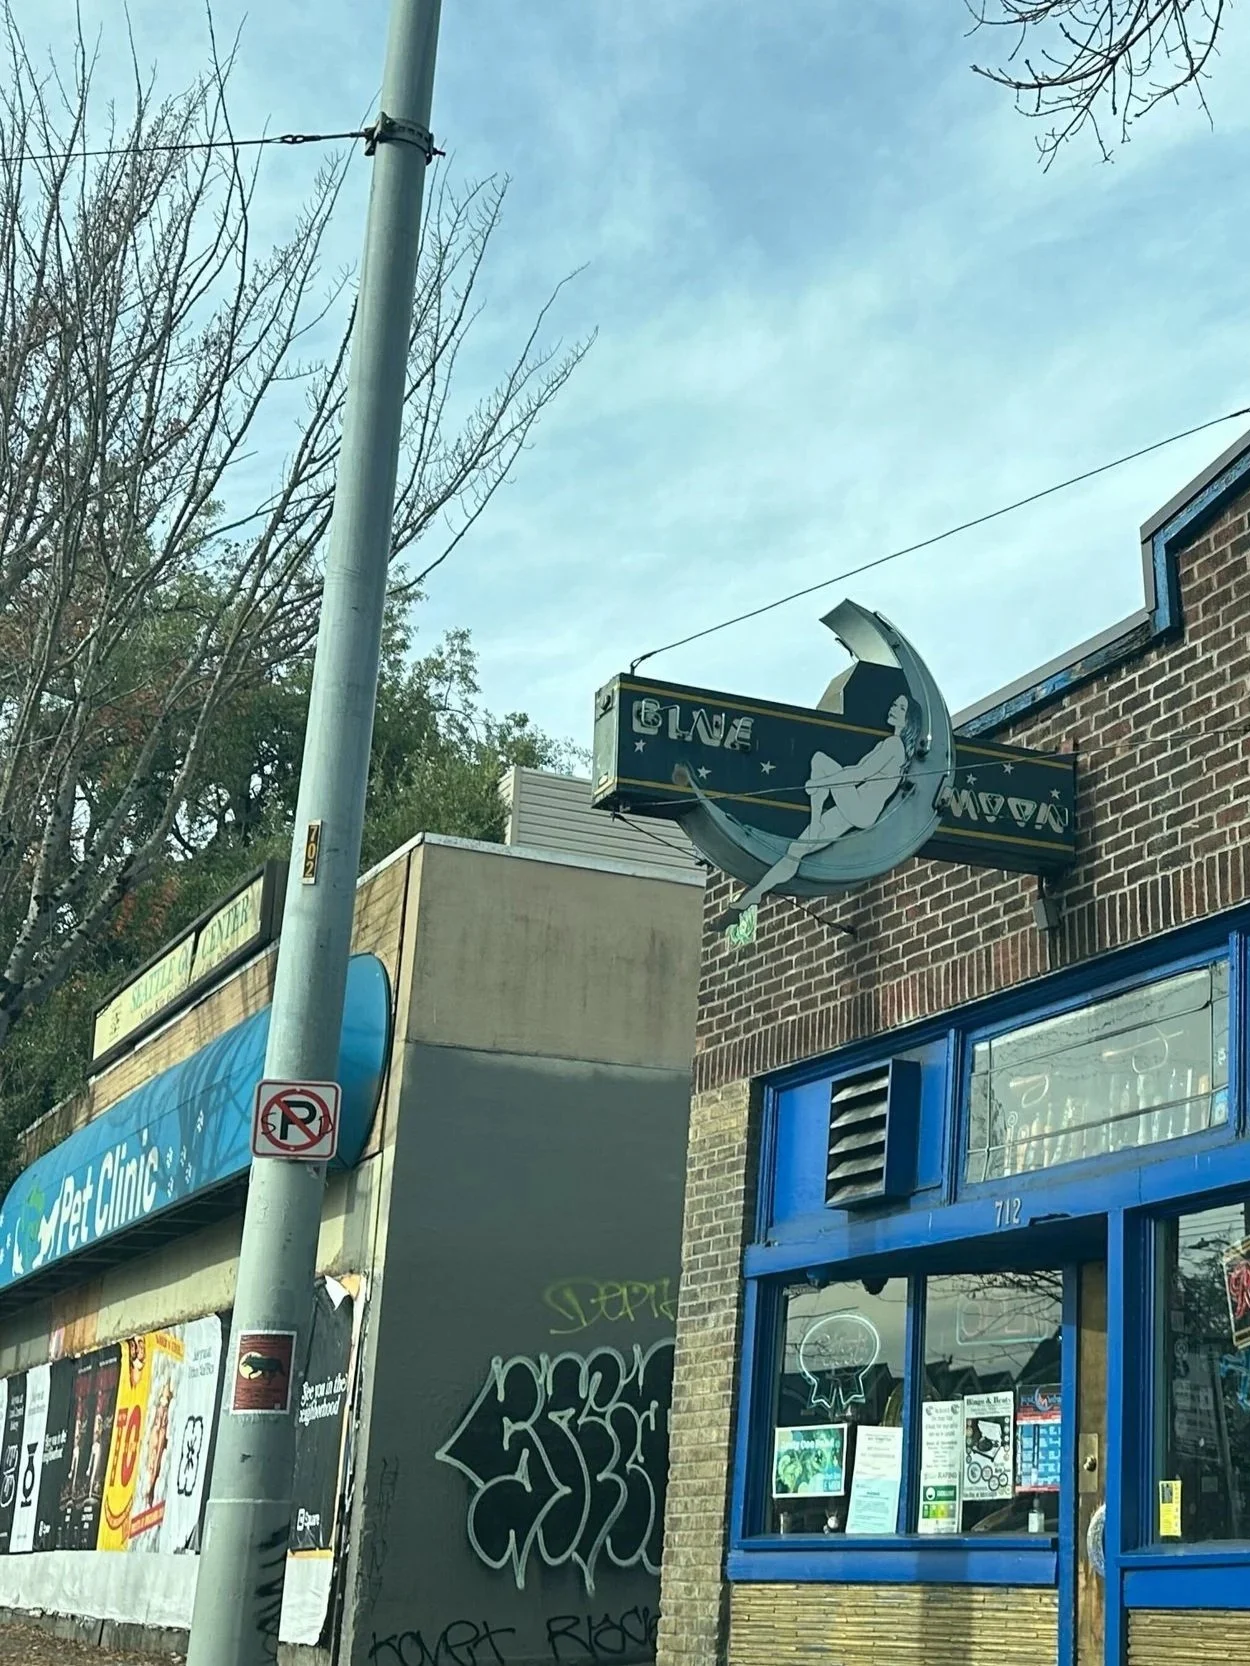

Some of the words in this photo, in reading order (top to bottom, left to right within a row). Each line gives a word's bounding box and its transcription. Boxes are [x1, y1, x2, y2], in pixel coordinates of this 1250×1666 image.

[632, 698, 755, 750] BLUE
[936, 786, 1069, 834] MOON
[304, 826, 319, 877] 702
[130, 955, 177, 1013] SEATTLE
[202, 895, 249, 960] CENTER
[280, 1100, 317, 1140] P
[56, 1166, 94, 1256] Pet
[95, 1128, 159, 1238] Clinic
[994, 1198, 1022, 1228] 712
[301, 1381, 314, 1407] See
[314, 1382, 325, 1400] you
[333, 1372, 347, 1394] the
